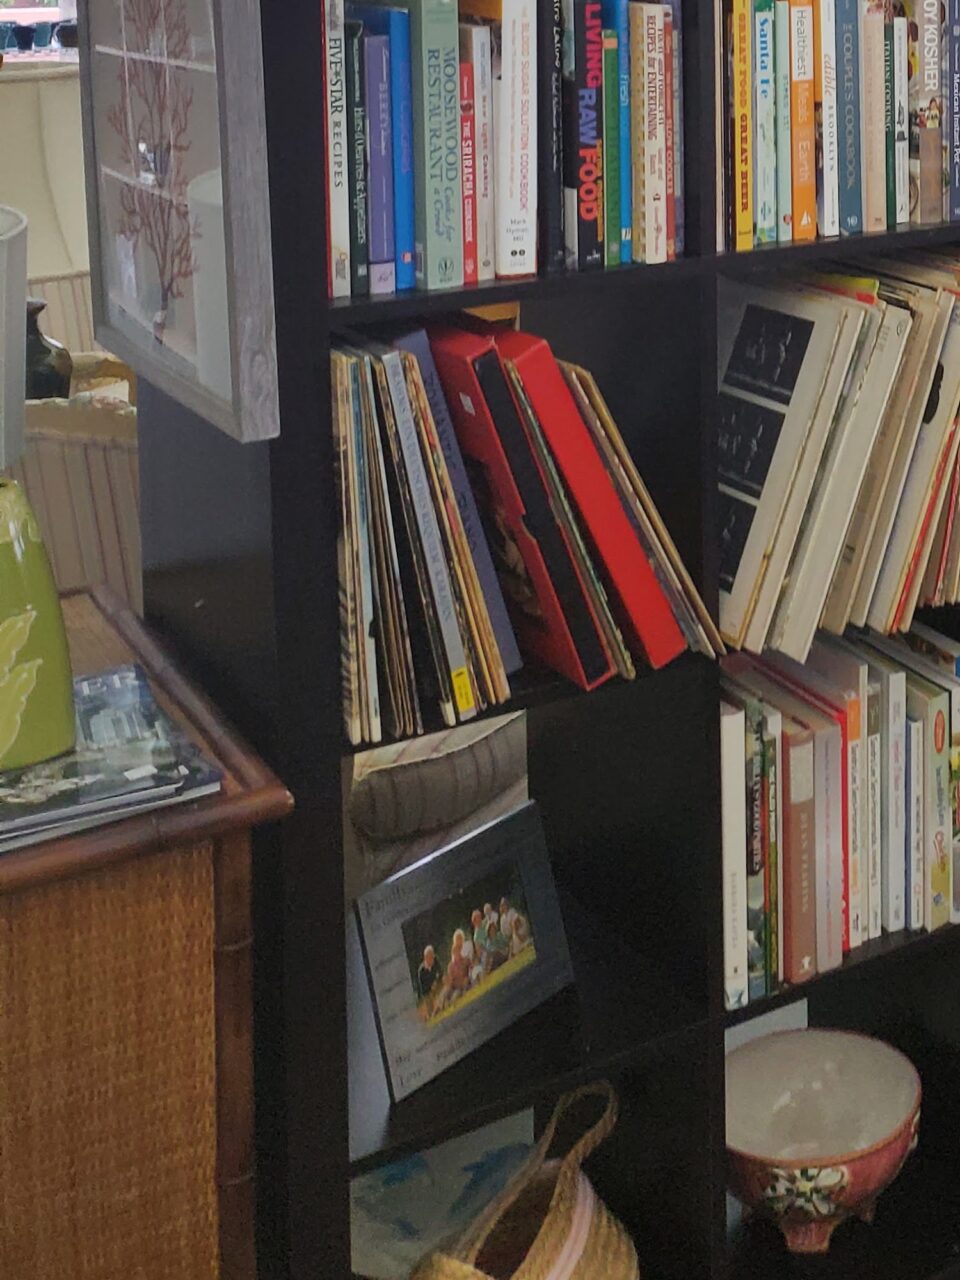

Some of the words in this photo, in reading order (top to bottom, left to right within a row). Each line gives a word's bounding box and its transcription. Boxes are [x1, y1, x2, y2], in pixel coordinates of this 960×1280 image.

[585, 2, 602, 89] LIVING
[647, 15, 656, 54] RECIPES
[739, 13, 747, 66] GREAT
[760, 17, 770, 70] Santa
[795, 9, 808, 78] Healthiest
[923, 24, 938, 92] KOSHER
[520, 60, 530, 96] SUGAR
[739, 69, 747, 110] FOOD
[823, 53, 835, 97] edible
[953, 73, 960, 112] Mexican
[427, 49, 443, 182] RESTAURANT
[443, 48, 458, 182] MOOSEWOOD
[463, 120, 471, 138] THE
[520, 99, 530, 151] SOLUTION
[579, 89, 597, 145] RAW
[647, 72, 657, 141] ENTERTAINING
[798, 82, 808, 123] Meals
[333, 120, 343, 188] RECIPES
[740, 113, 748, 168] GREAT
[798, 140, 810, 181] Earth
[844, 104, 855, 189] COOKBOOK
[953, 148, 960, 162] Pot
[462, 140, 473, 196] SRIRACHA
[519, 153, 529, 209] COOKBOOK
[579, 148, 598, 221] FOOD
[740, 171, 748, 213] BEER
